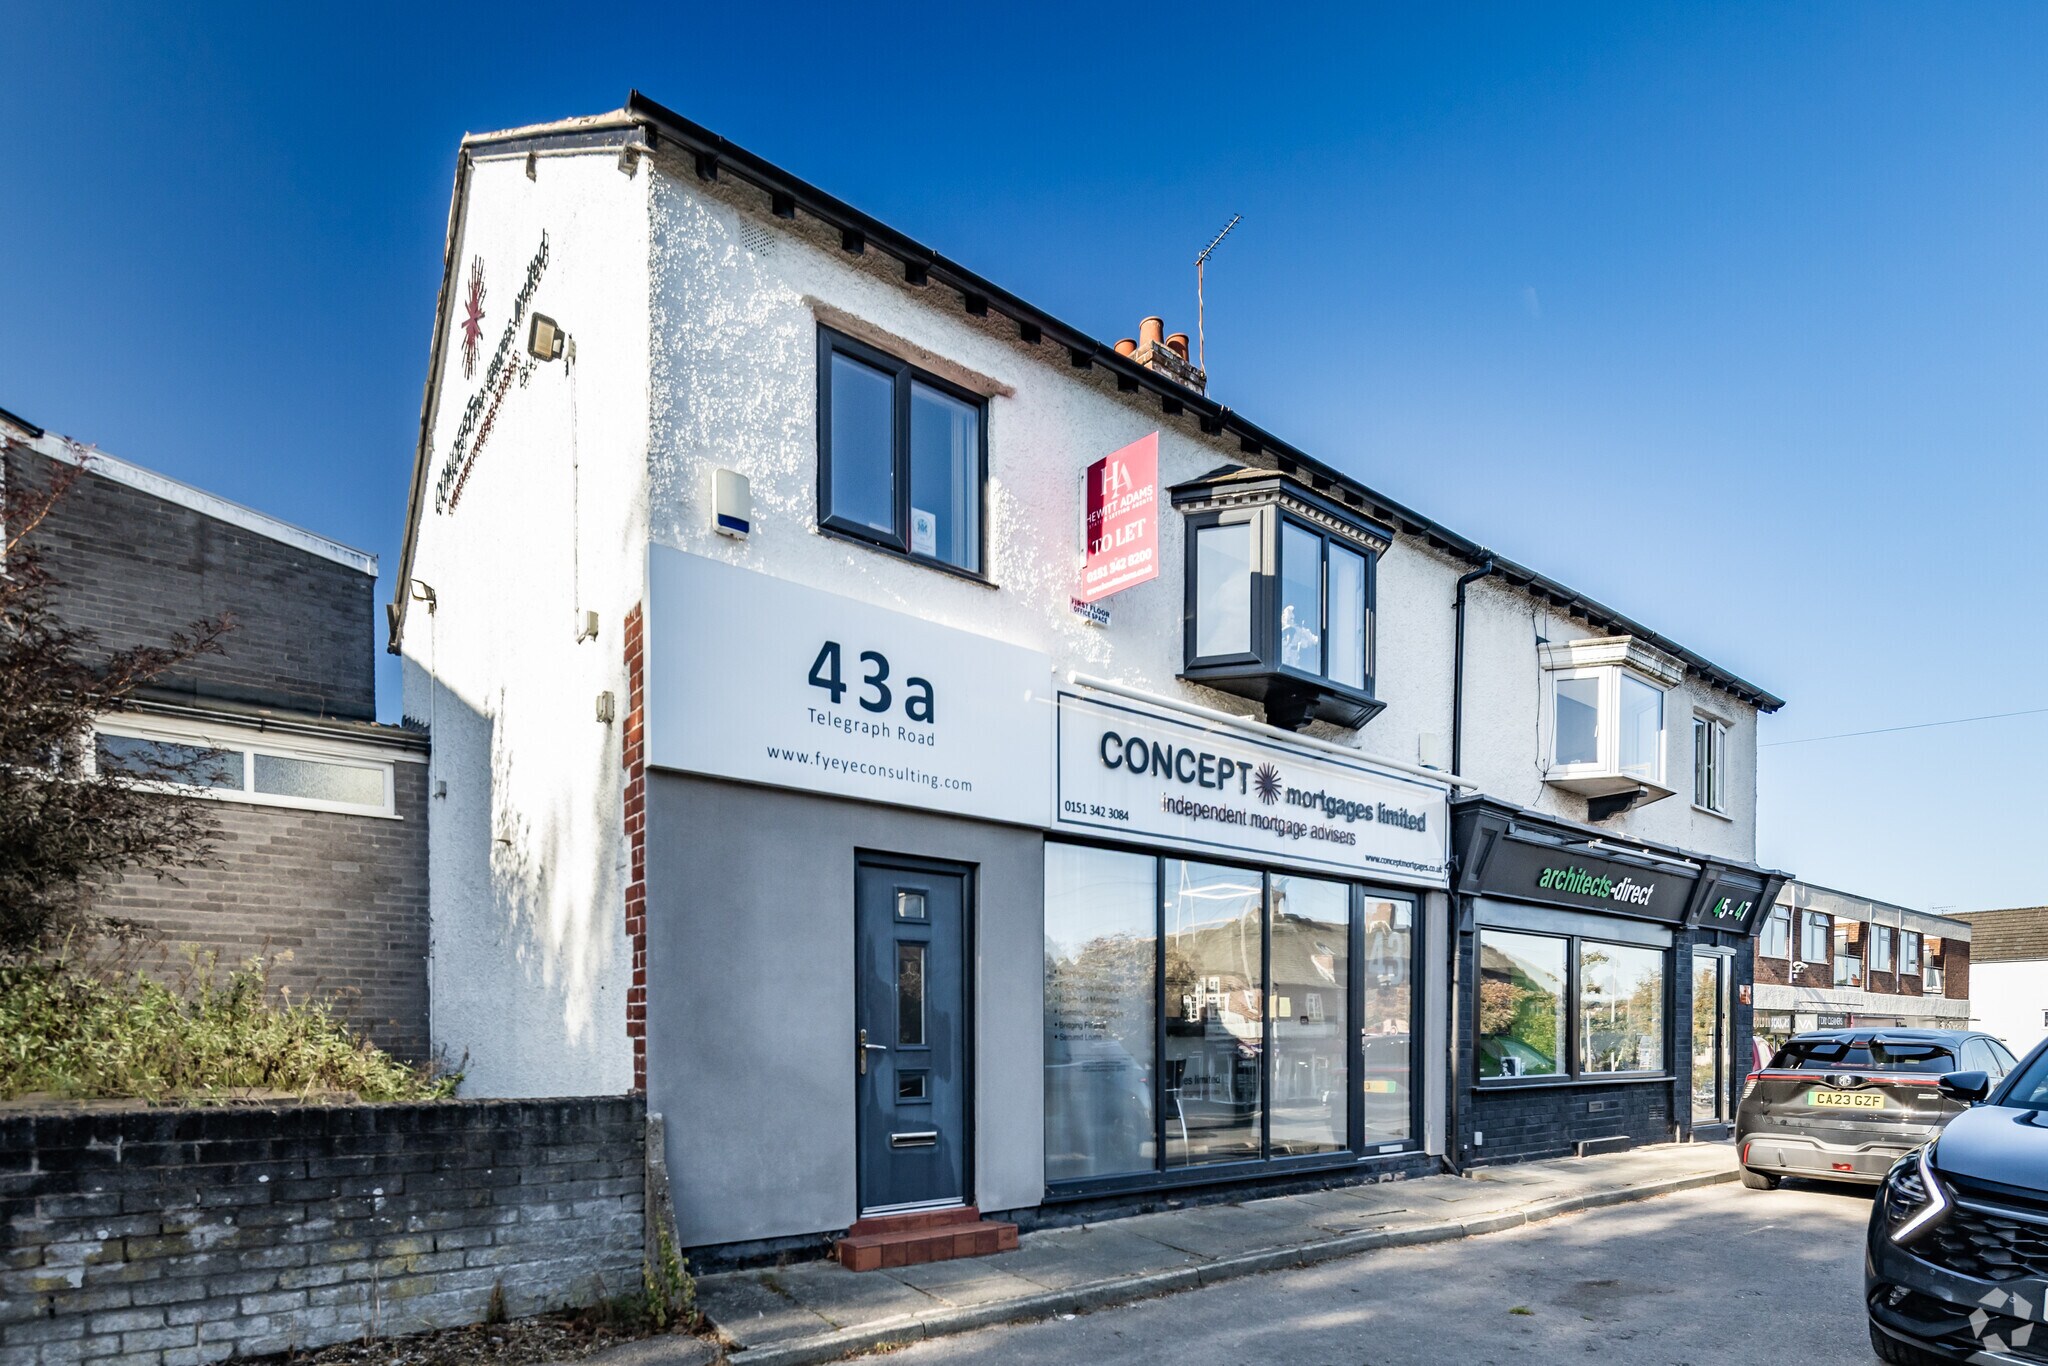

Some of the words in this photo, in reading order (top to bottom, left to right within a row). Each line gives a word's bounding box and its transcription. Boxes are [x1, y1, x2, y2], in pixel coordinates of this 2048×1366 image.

[1087, 500, 1118, 523] HEWITT
[1120, 484, 1153, 508] ADAMS
[1092, 532, 1112, 556] TO
[1115, 518, 1146, 547] LET
[1071, 597, 1089, 610] FIRST
[1090, 604, 1110, 618] FLOOR
[1073, 606, 1091, 618] OFFICE
[1091, 612, 1108, 624] SPACE
[808, 640, 935, 724] 43a
[808, 707, 890, 738] Telegraph
[898, 726, 935, 747] Road
[767, 746, 973, 792] www.fyeyeconsulting.com
[1101, 731, 1253, 795] CONCEPT
[1285, 785, 1373, 823] mortgages
[1377, 803, 1427, 832] limited
[1065, 800, 1088, 815] 0151
[1089, 804, 1107, 818] 342
[1107, 807, 1130, 822] 3084
[1161, 791, 1247, 826] independent
[1249, 811, 1308, 841] mortgage
[1310, 820, 1357, 846] advisers
[1539, 865, 1655, 907] architects-direct
[1713, 897, 1730, 919] 45
[1734, 901, 1752, 922] 47
[1817, 1093, 1851, 1105] CA23
[1854, 1095, 1882, 1107] GZF
